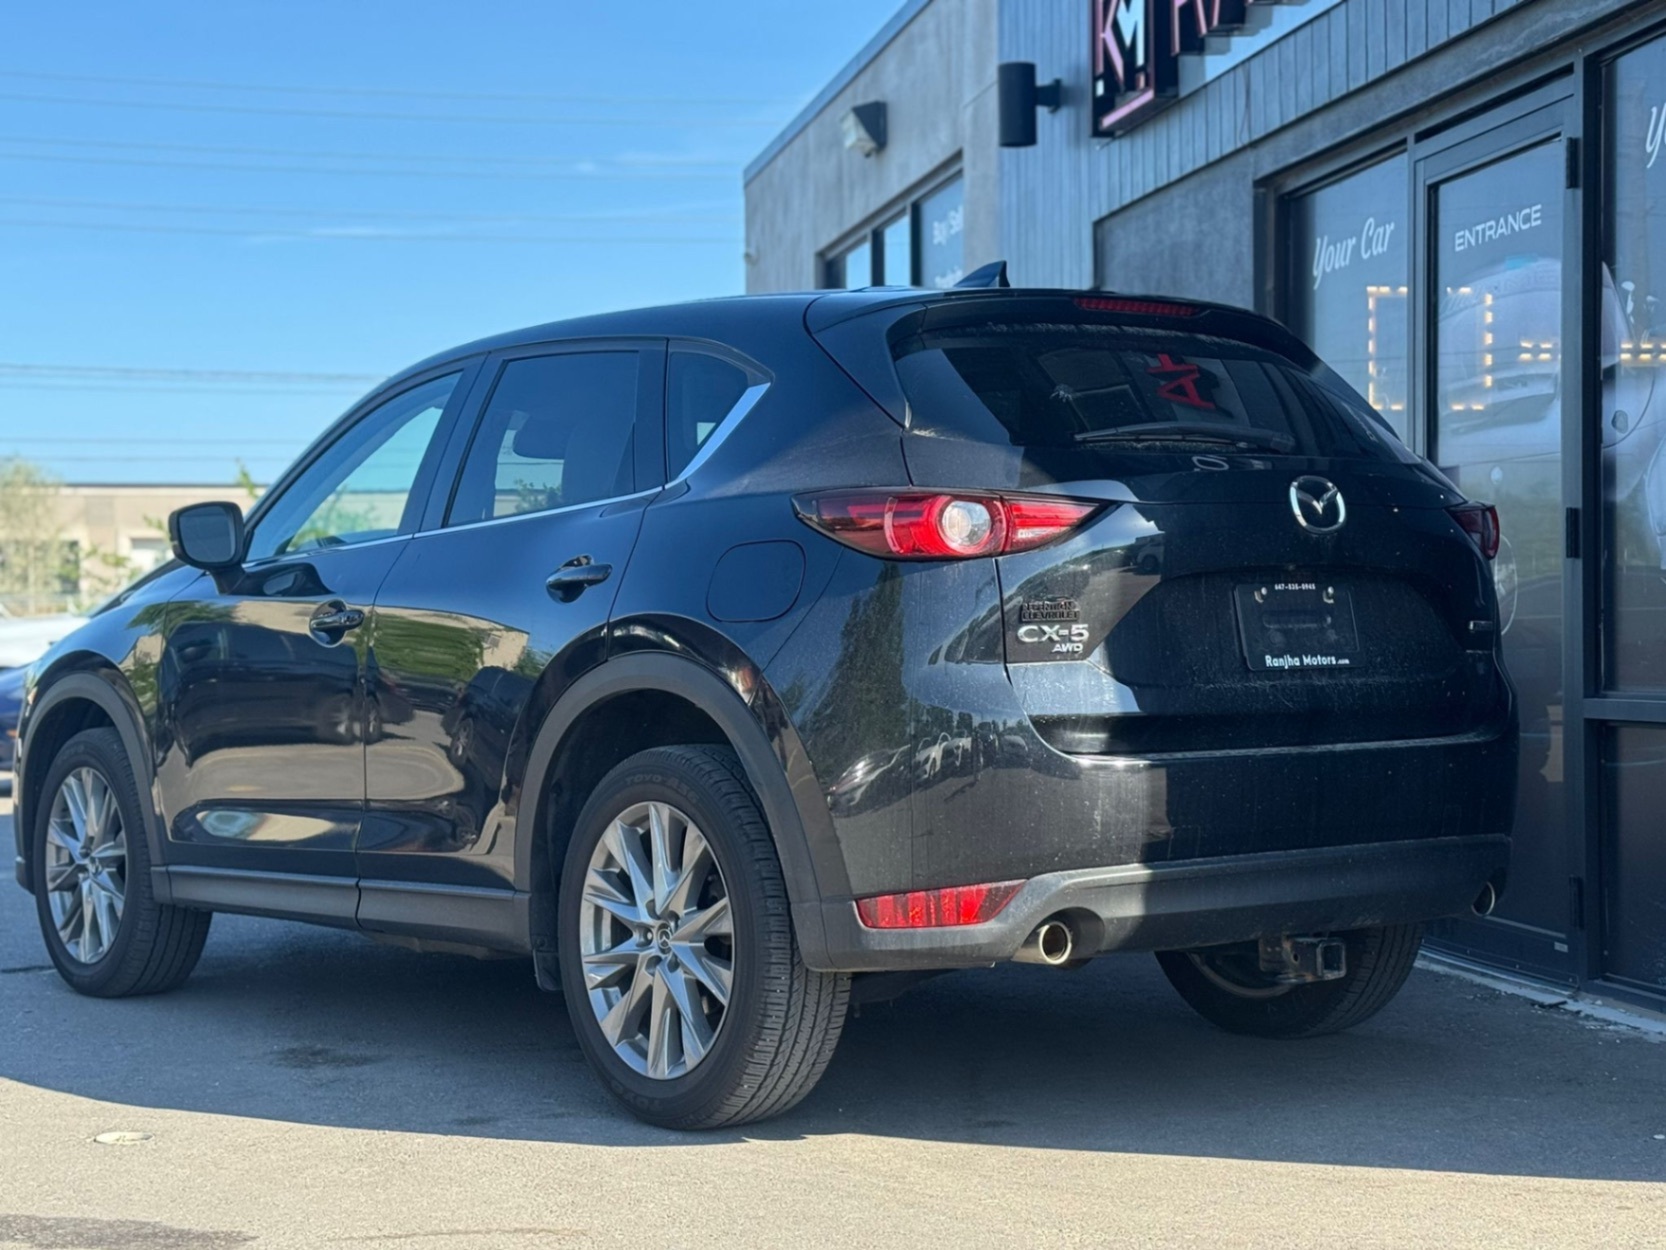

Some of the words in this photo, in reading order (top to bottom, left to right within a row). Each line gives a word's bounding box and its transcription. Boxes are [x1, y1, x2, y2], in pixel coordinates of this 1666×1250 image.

[1454, 203, 1542, 252] ENTRANCE
[1312, 234, 1356, 291] Your
[1361, 216, 1395, 260] Car
[1017, 624, 1090, 643] CX-5
[1051, 642, 1084, 654] AWD
[1265, 654, 1300, 670] Ranjha
[1302, 654, 1336, 666] Motors
[625, 773, 662, 787] TOYO
